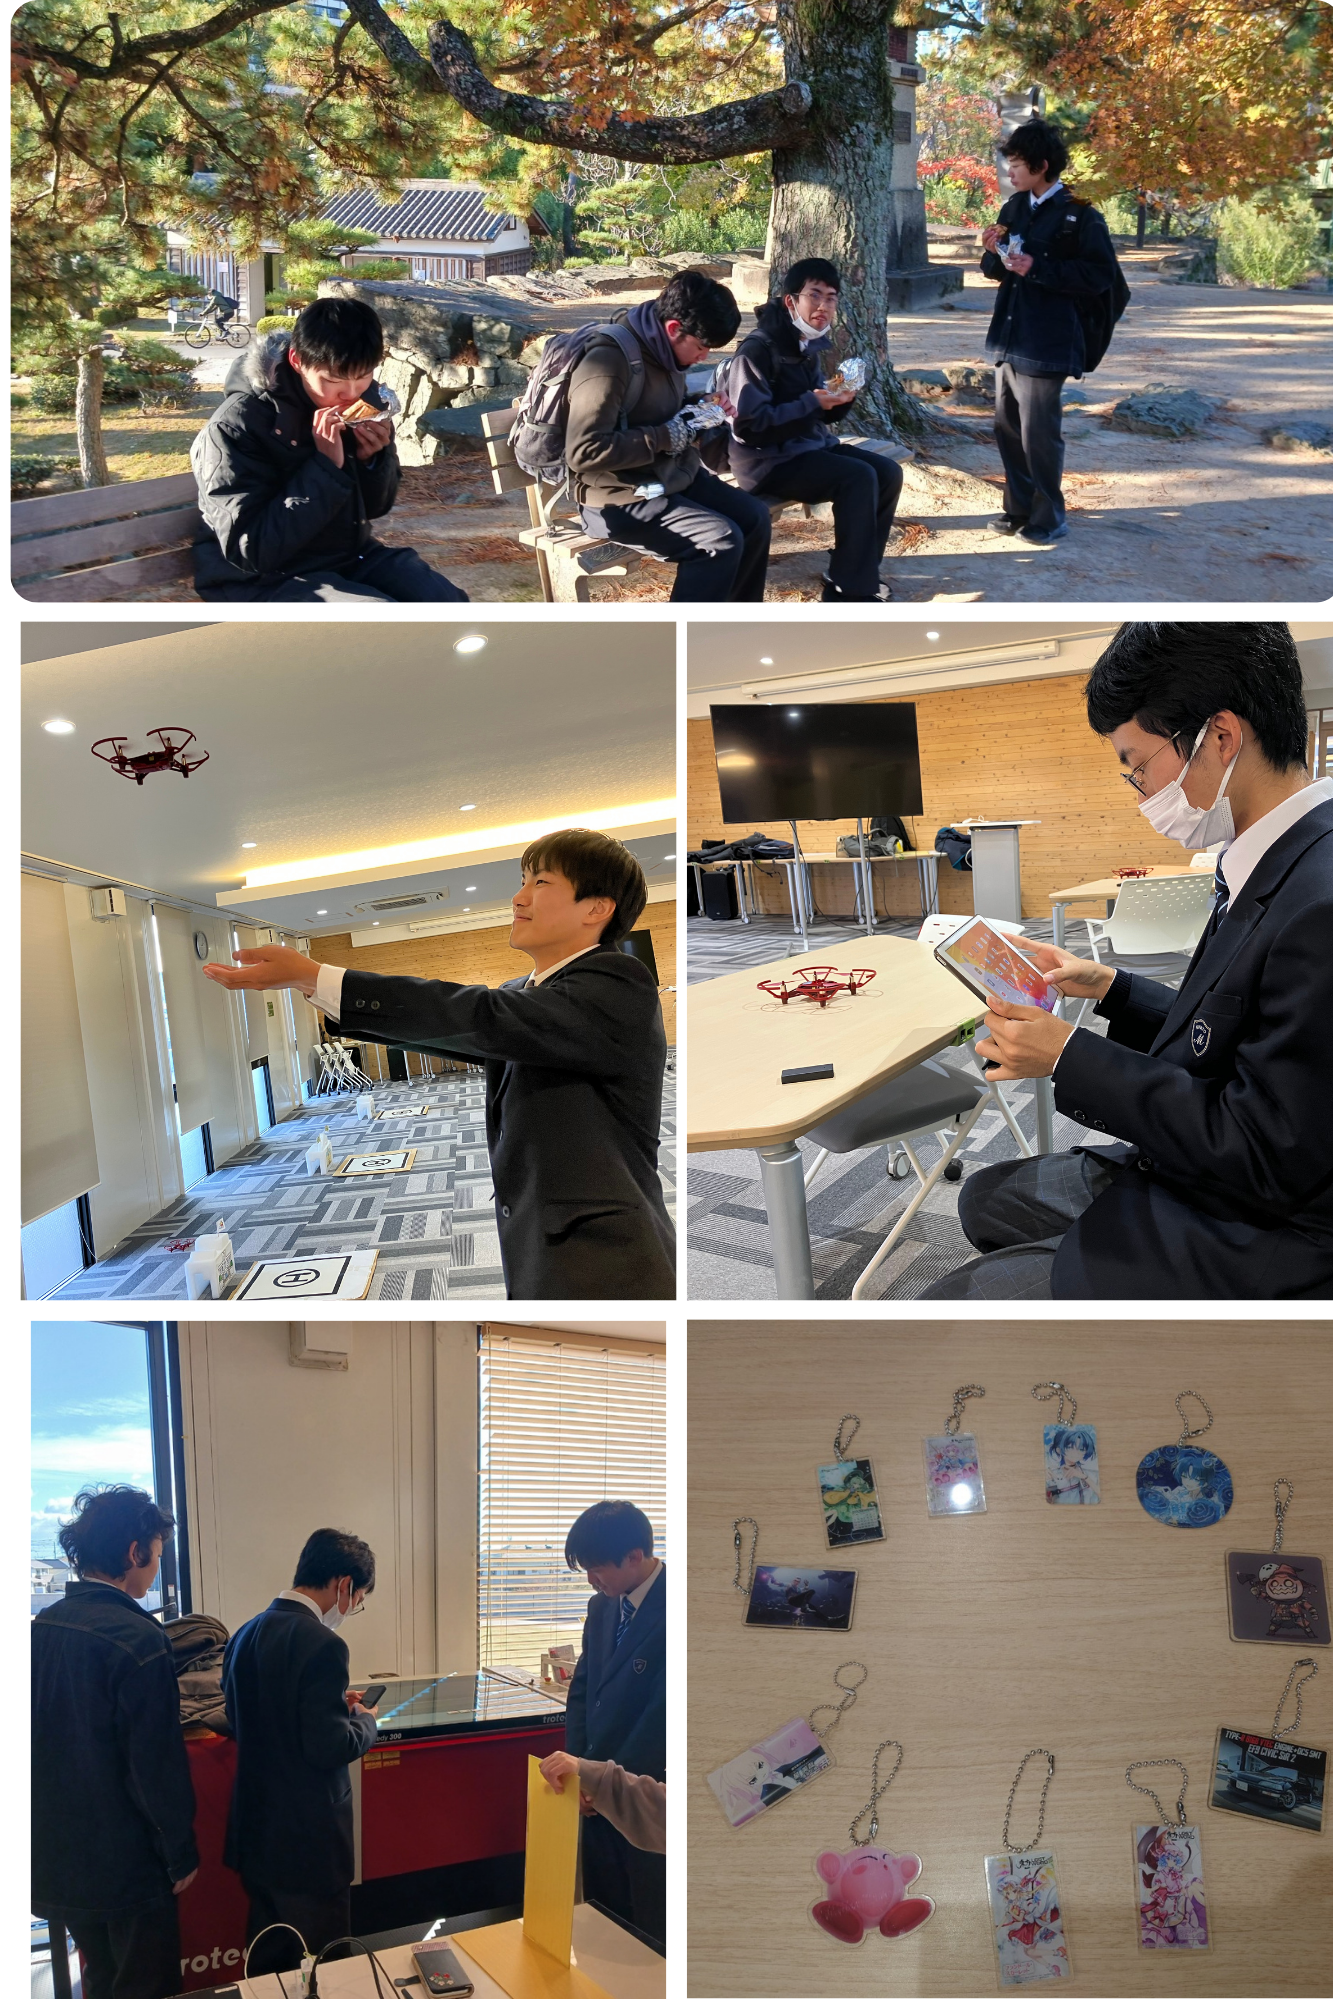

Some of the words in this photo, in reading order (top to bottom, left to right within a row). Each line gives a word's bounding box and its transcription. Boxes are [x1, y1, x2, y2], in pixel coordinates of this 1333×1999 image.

[543, 1714, 566, 1723] trote
[389, 1732, 402, 1741] 300
[1260, 1739, 1274, 1748] VTEC
[1248, 1744, 1261, 1754] EF9
[1261, 1747, 1278, 1758] CIVIC
[181, 1947, 247, 1976] rote
